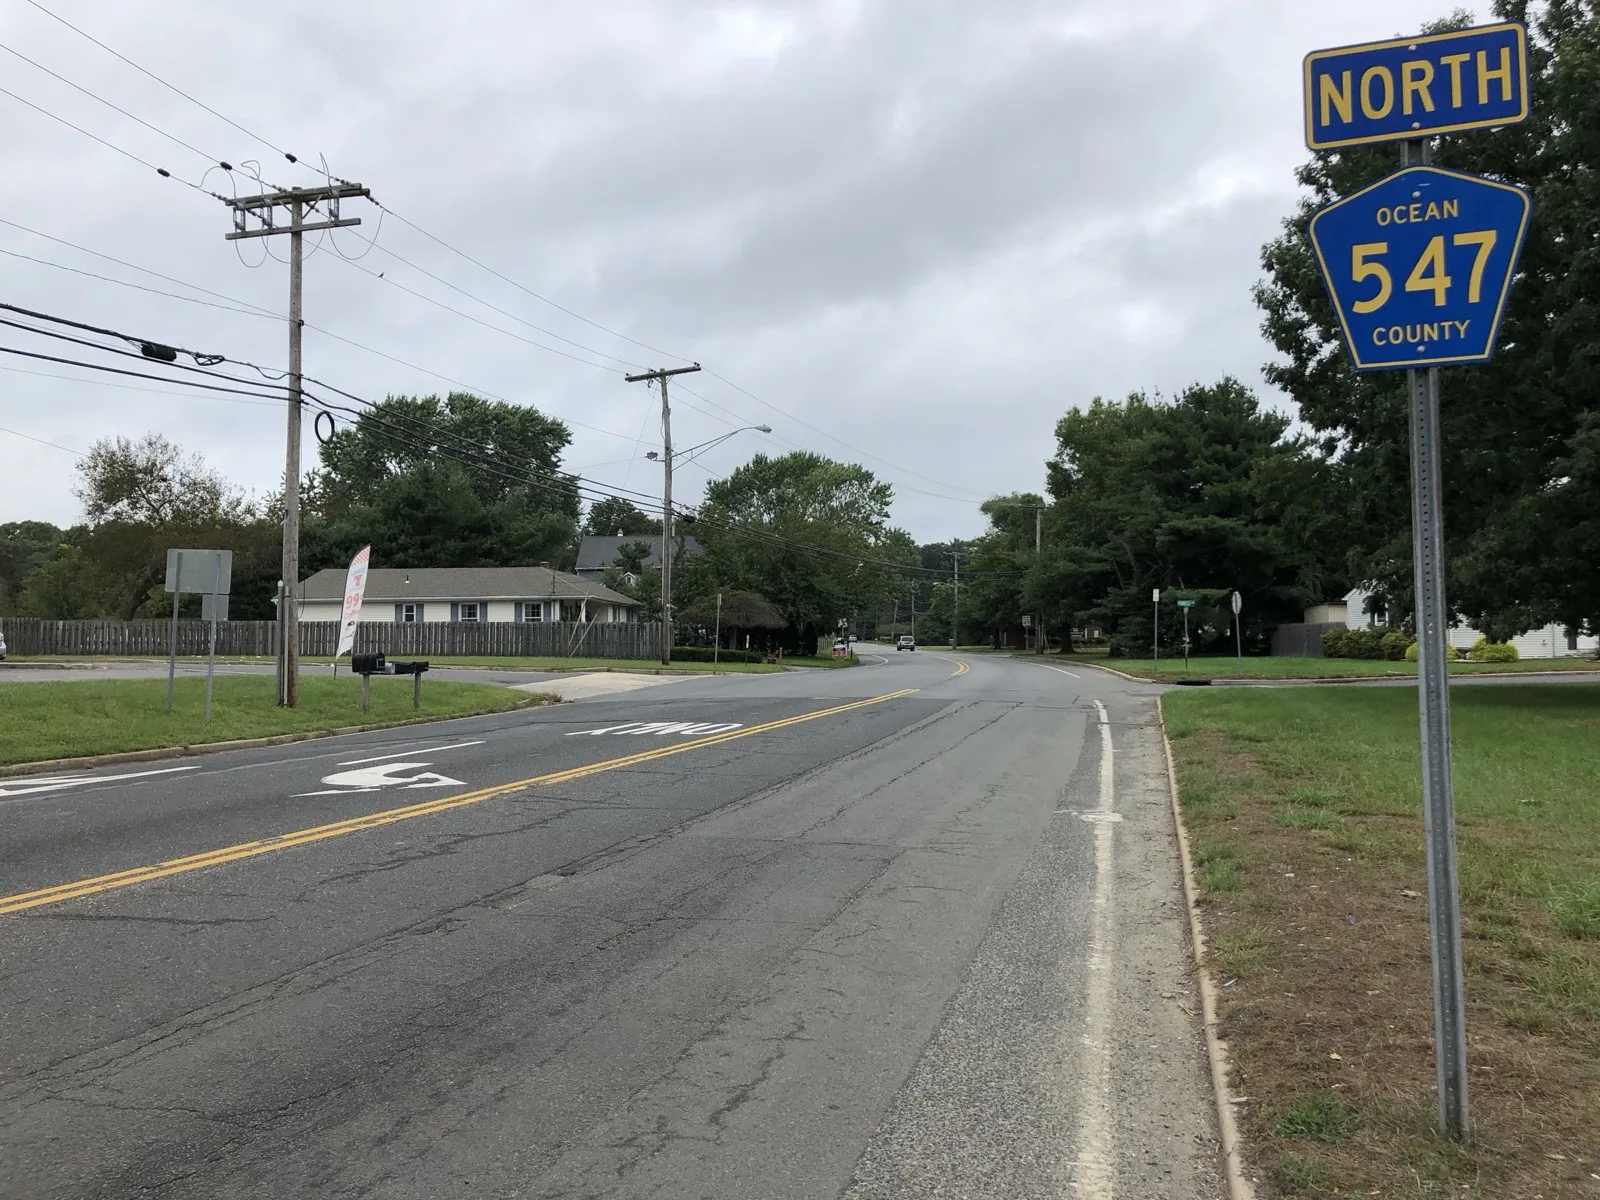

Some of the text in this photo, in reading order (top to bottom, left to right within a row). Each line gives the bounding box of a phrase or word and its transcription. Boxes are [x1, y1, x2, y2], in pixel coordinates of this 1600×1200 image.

[1319, 47, 1512, 127] NORTH
[1376, 199, 1459, 226] OCEAN
[1352, 230, 1497, 314] 547
[1372, 319, 1471, 346] COUNTY
[564, 722, 743, 736] ONLY
